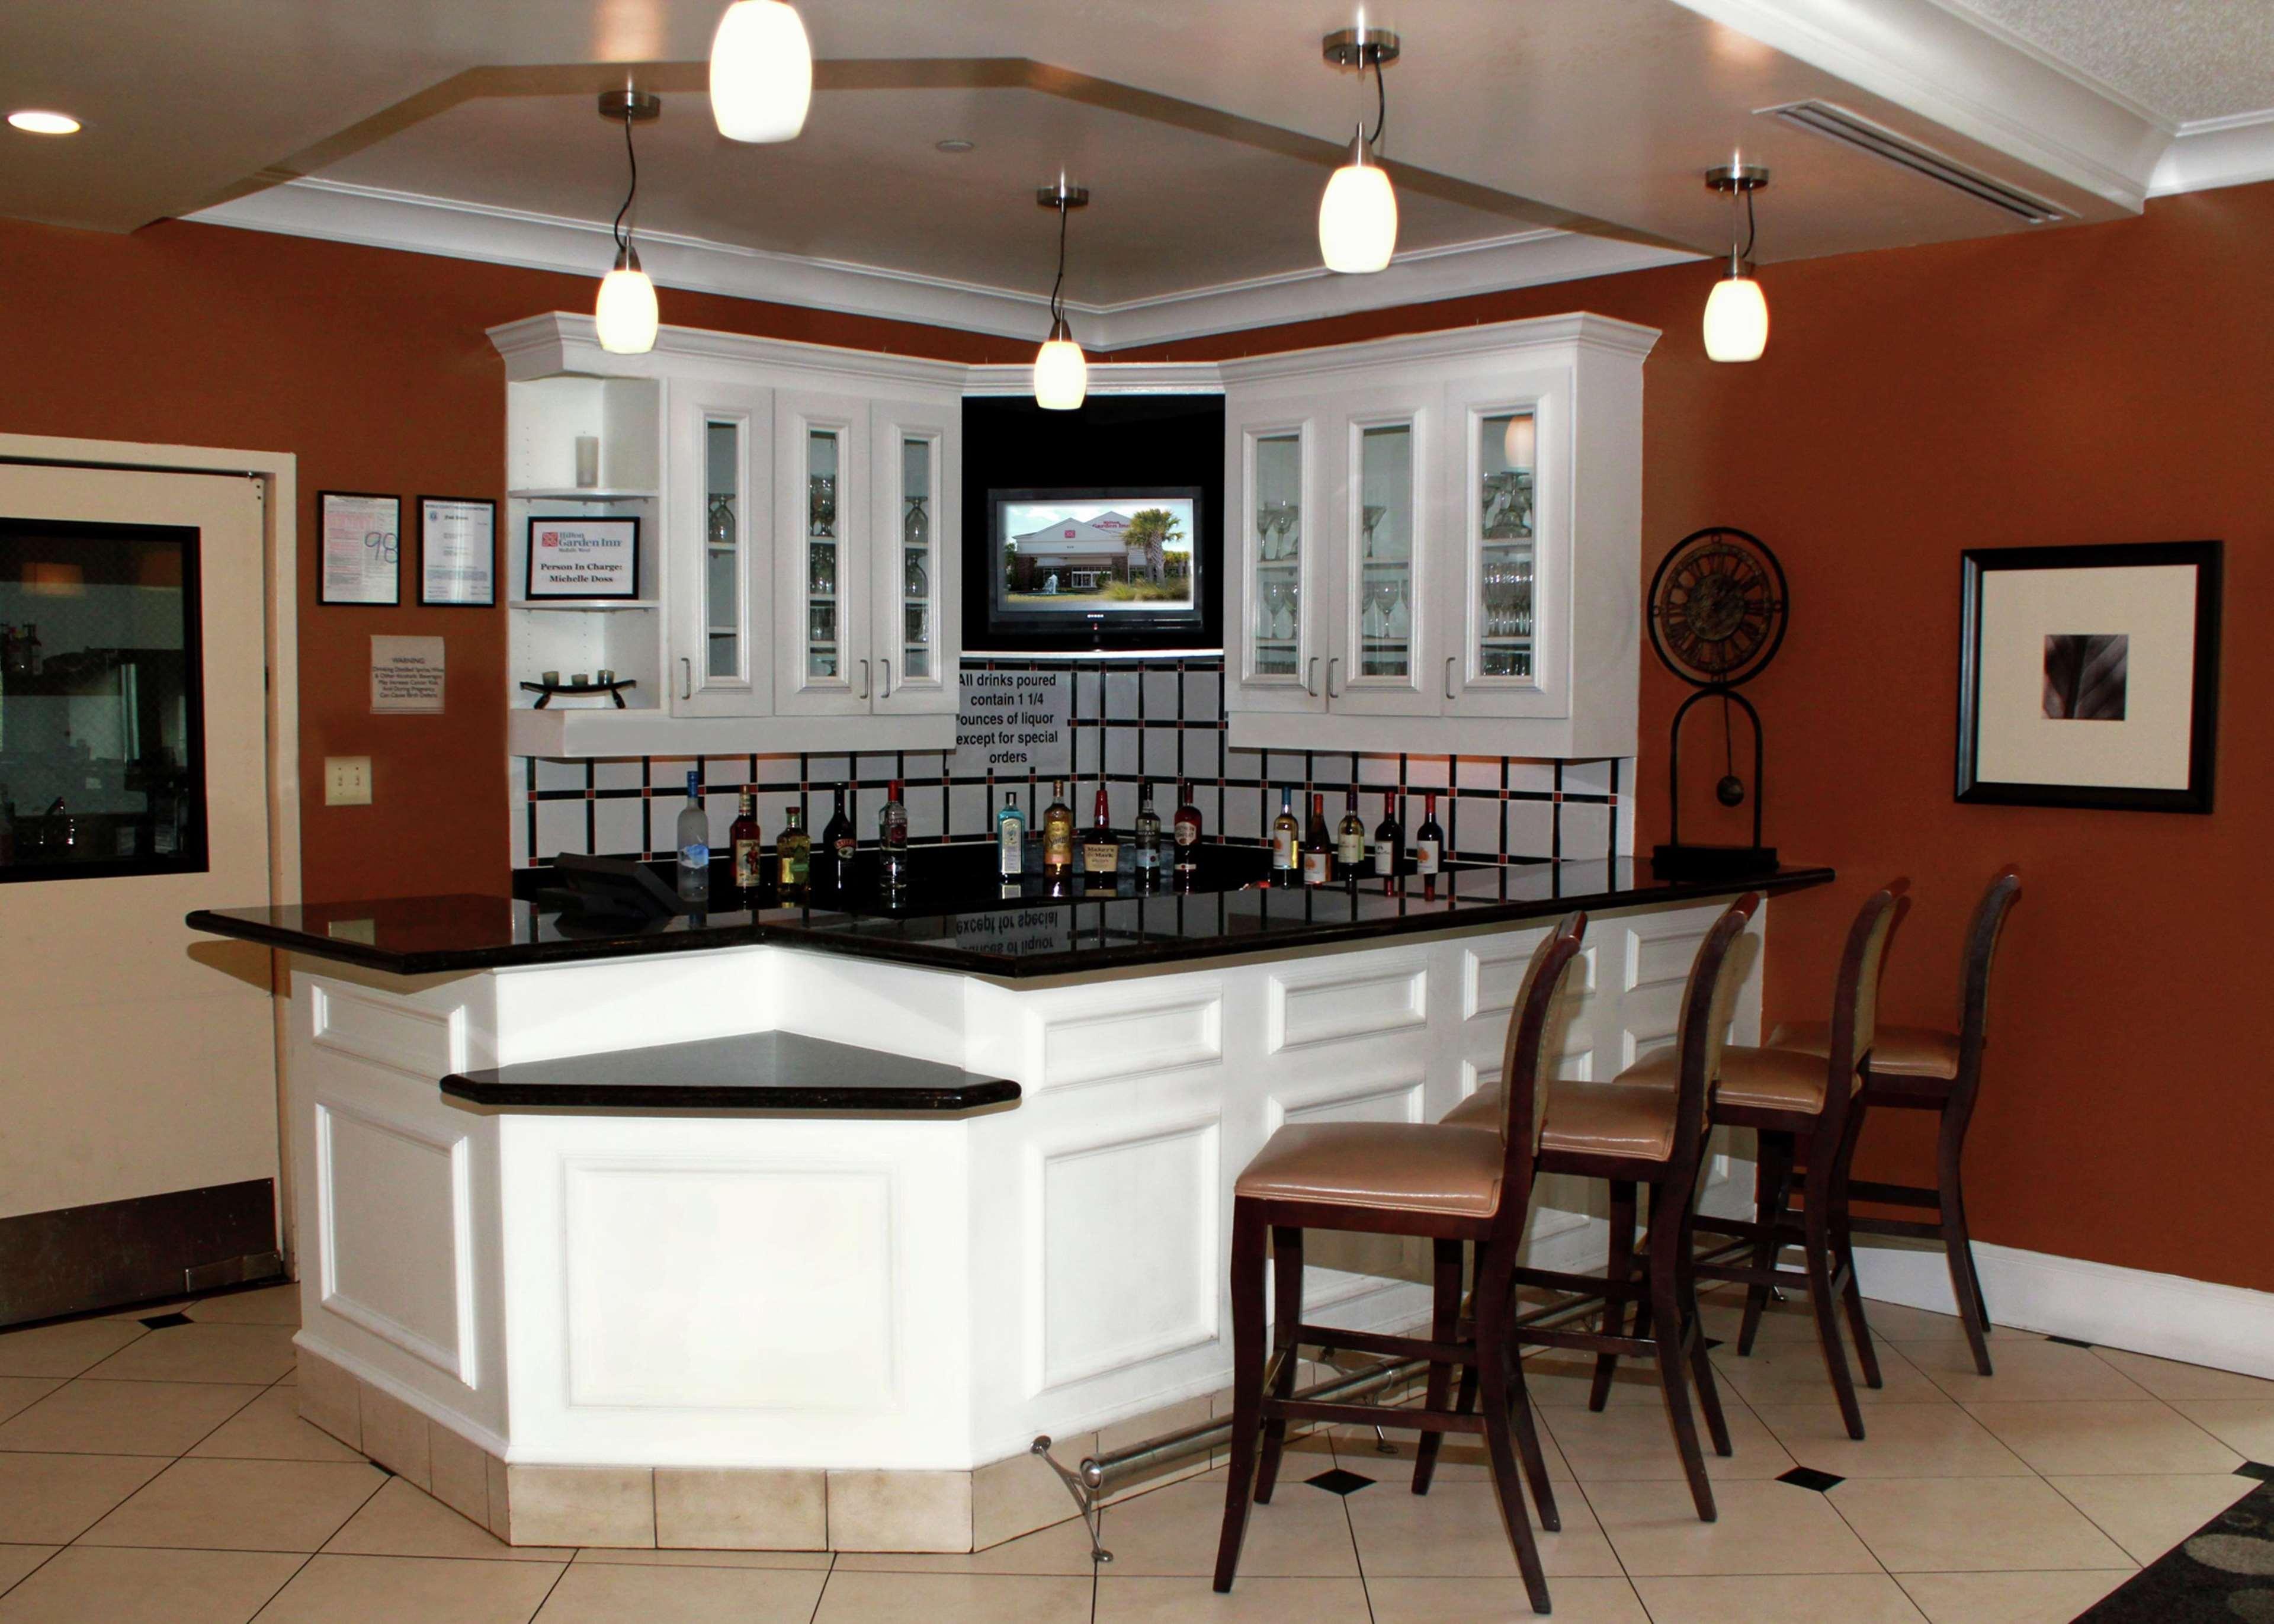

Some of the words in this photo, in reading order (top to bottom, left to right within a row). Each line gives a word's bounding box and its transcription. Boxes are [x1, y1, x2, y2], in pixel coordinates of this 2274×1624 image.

[364, 532, 397, 564] 98
[559, 538, 599, 547] Garden
[601, 538, 621, 547] Inn
[587, 563, 623, 572] Charge:
[959, 673, 973, 686] All
[977, 673, 1013, 686] drinks
[1016, 673, 1056, 689] poured
[970, 693, 1014, 706] contain
[1018, 693, 1023, 705] 1
[1028, 692, 1044, 705] 1/4
[960, 714, 1003, 726] ounces
[1006, 712, 1018, 724] of
[1021, 712, 1054, 727] liquor
[956, 732, 996, 747] except
[998, 731, 1015, 744] for
[1017, 730, 1058, 746] special
[989, 750, 1028, 763] orders
